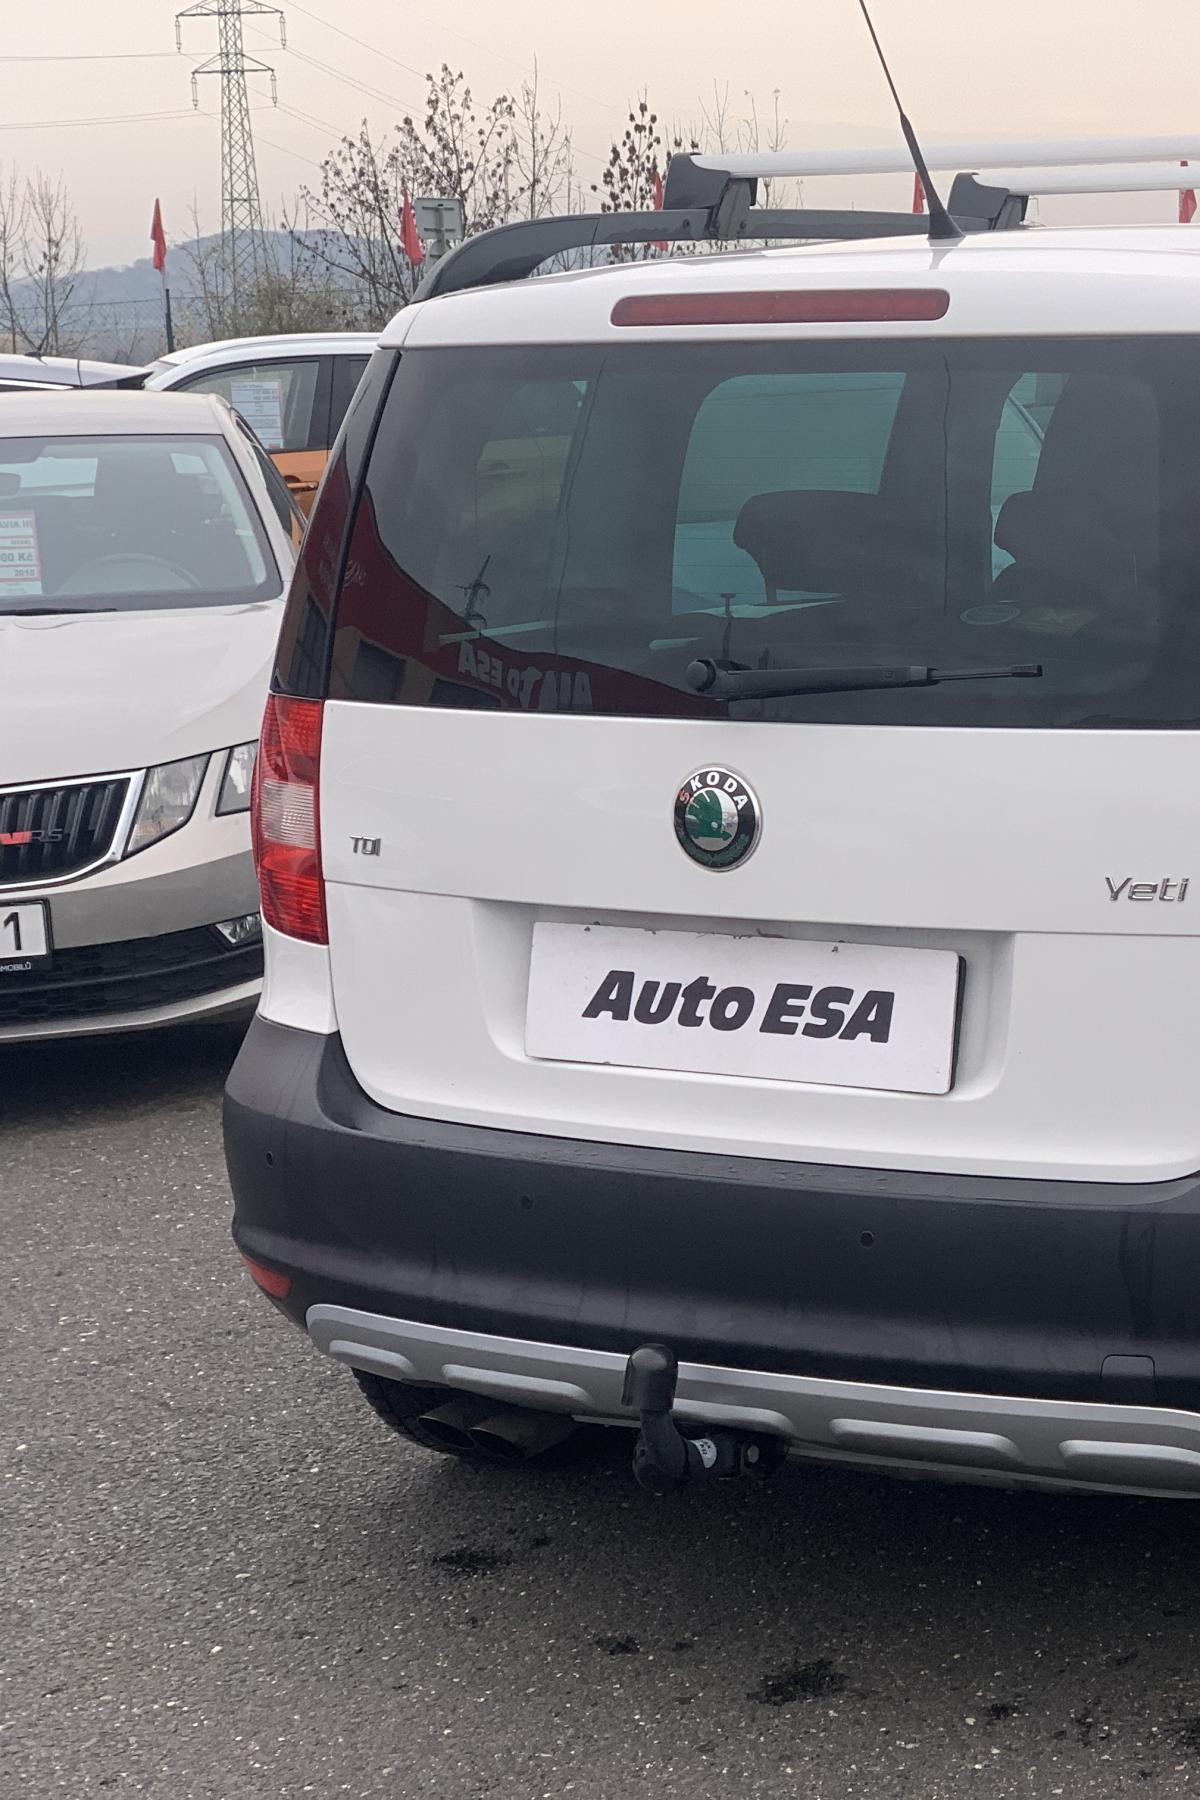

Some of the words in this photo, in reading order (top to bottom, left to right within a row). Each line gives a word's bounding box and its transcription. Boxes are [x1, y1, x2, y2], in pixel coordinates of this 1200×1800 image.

[349, 835, 381, 856] TDI
[1105, 877, 1190, 902] Yeti
[582, 970, 755, 1031] Auto
[759, 983, 895, 1043] ESA
